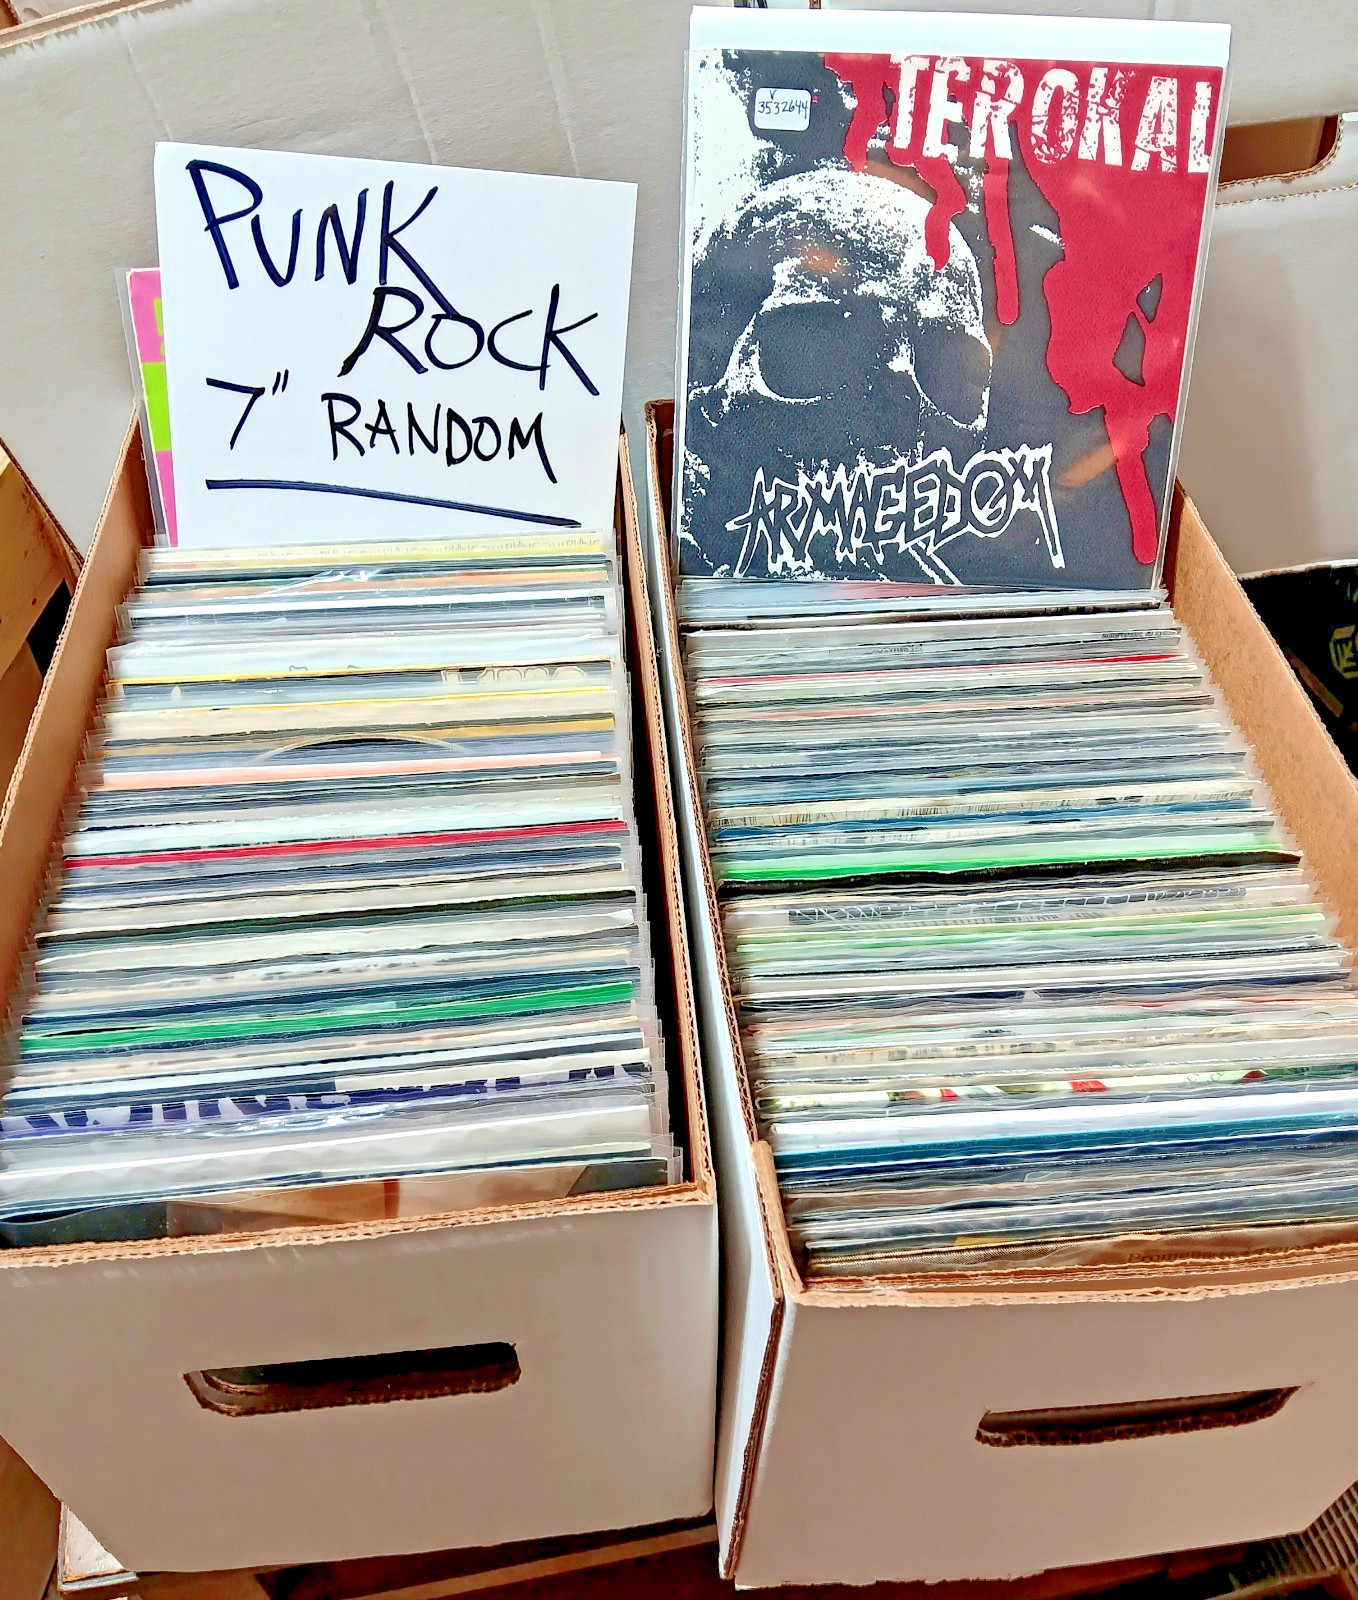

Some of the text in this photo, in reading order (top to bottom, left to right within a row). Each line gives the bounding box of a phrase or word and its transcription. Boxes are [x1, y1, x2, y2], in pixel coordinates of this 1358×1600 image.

[757, 99, 809, 119] 3532644
[186, 158, 455, 316] PUNK
[337, 283, 600, 397] ROCK
[205, 369, 558, 484] 7" RANDOM
